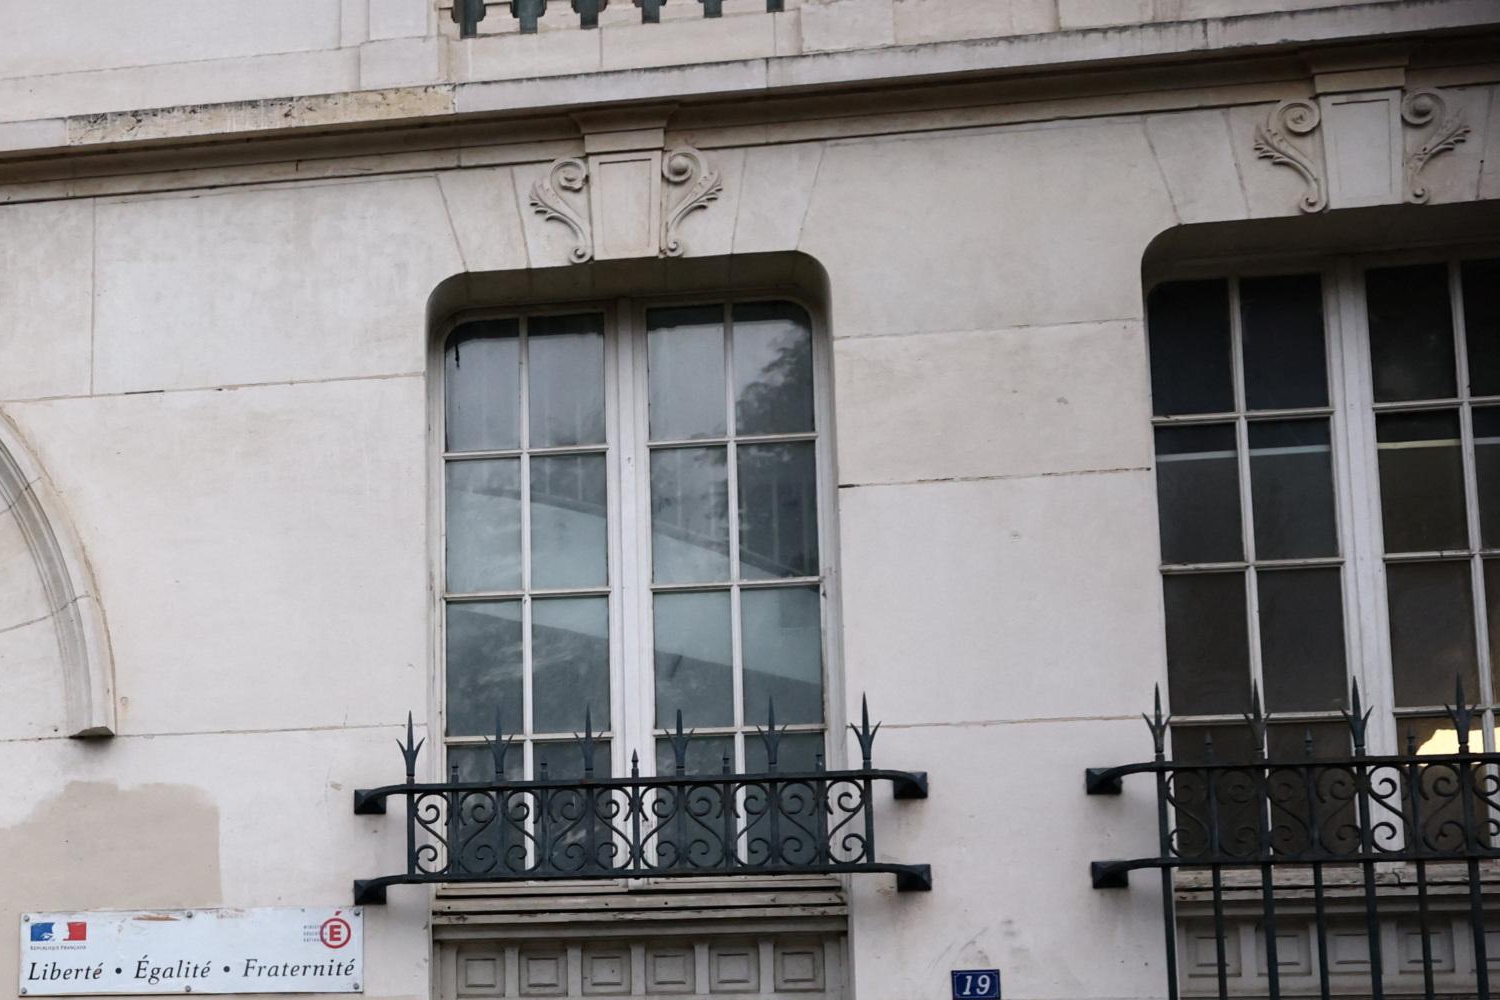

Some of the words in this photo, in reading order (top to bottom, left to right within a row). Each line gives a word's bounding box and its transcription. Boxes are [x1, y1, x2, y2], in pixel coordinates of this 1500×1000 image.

[28, 961, 103, 981] Liberté
[134, 955, 212, 985] Égalité
[242, 957, 356, 979] Fraternité
[962, 974, 991, 996] 19
